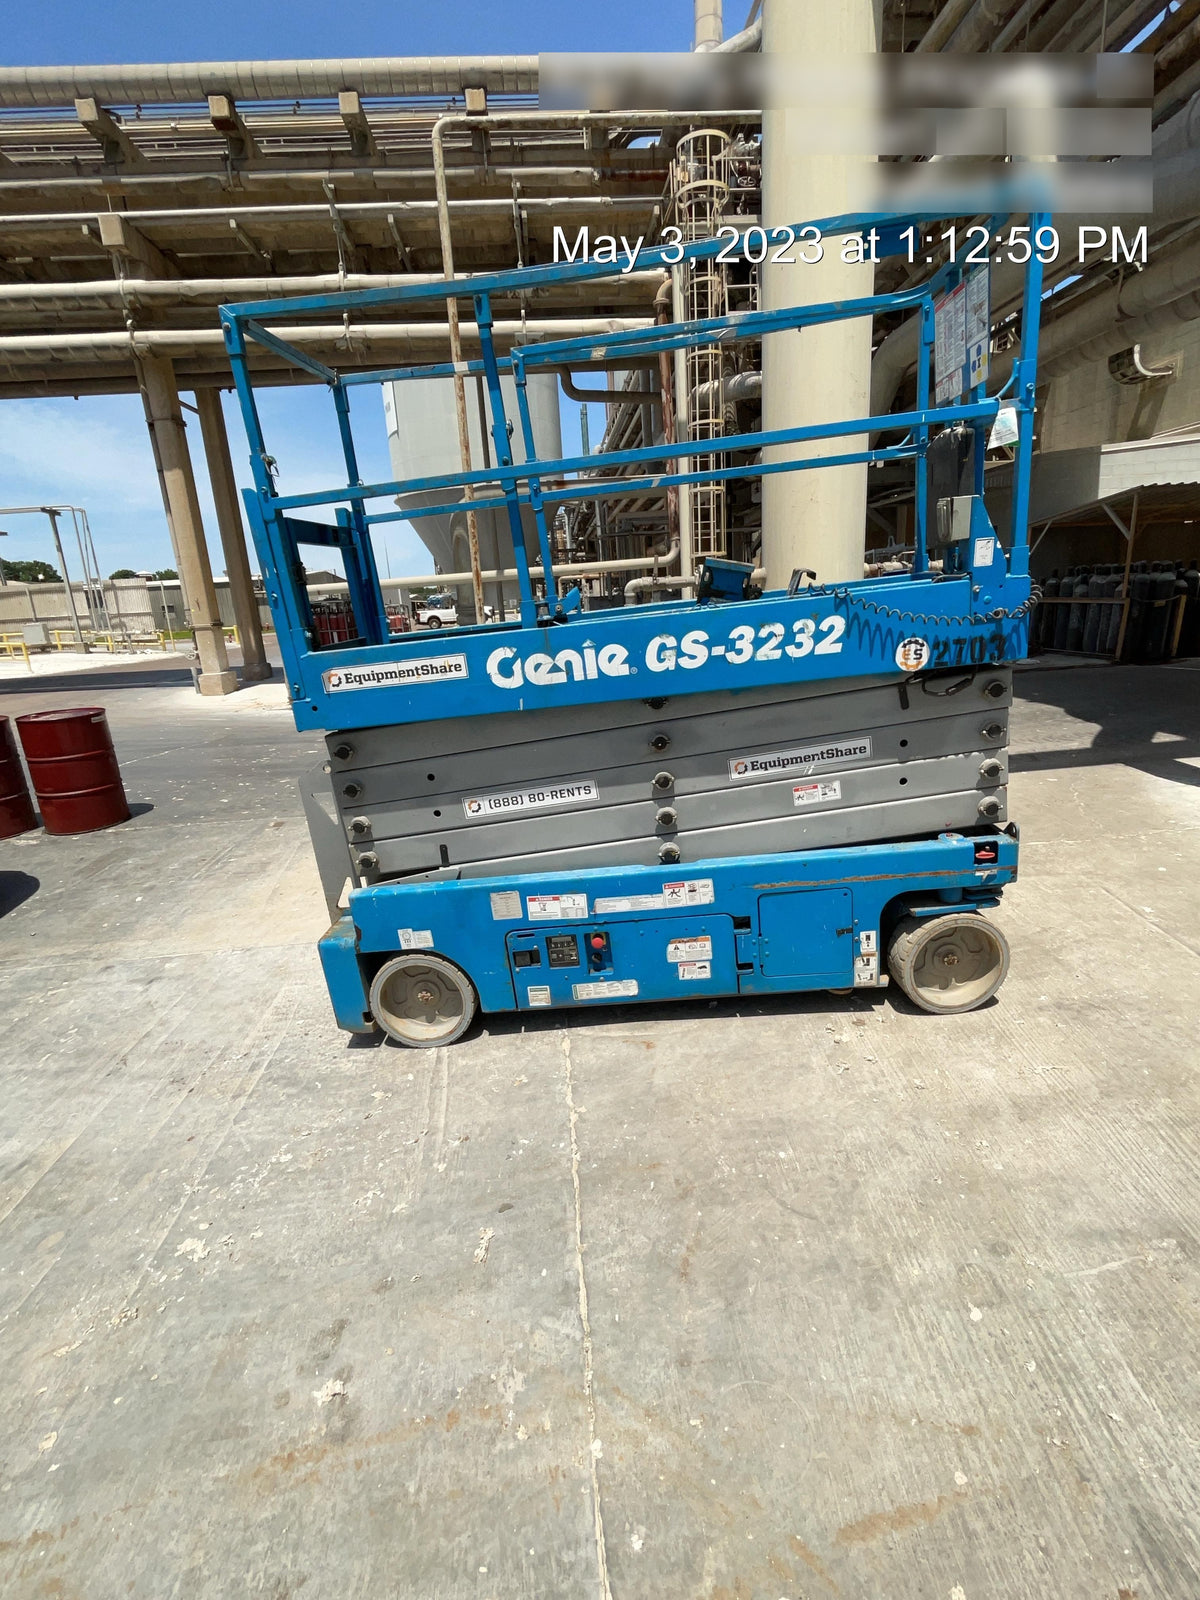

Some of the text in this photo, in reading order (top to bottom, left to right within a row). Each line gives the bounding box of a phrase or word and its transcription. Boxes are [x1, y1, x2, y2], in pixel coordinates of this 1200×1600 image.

[486, 614, 846, 689] Genie GS-3232
[344, 660, 463, 686] EquipmentShare
[750, 743, 868, 772] EquipmentShare
[488, 785, 593, 811] (888) 80-RENTS
